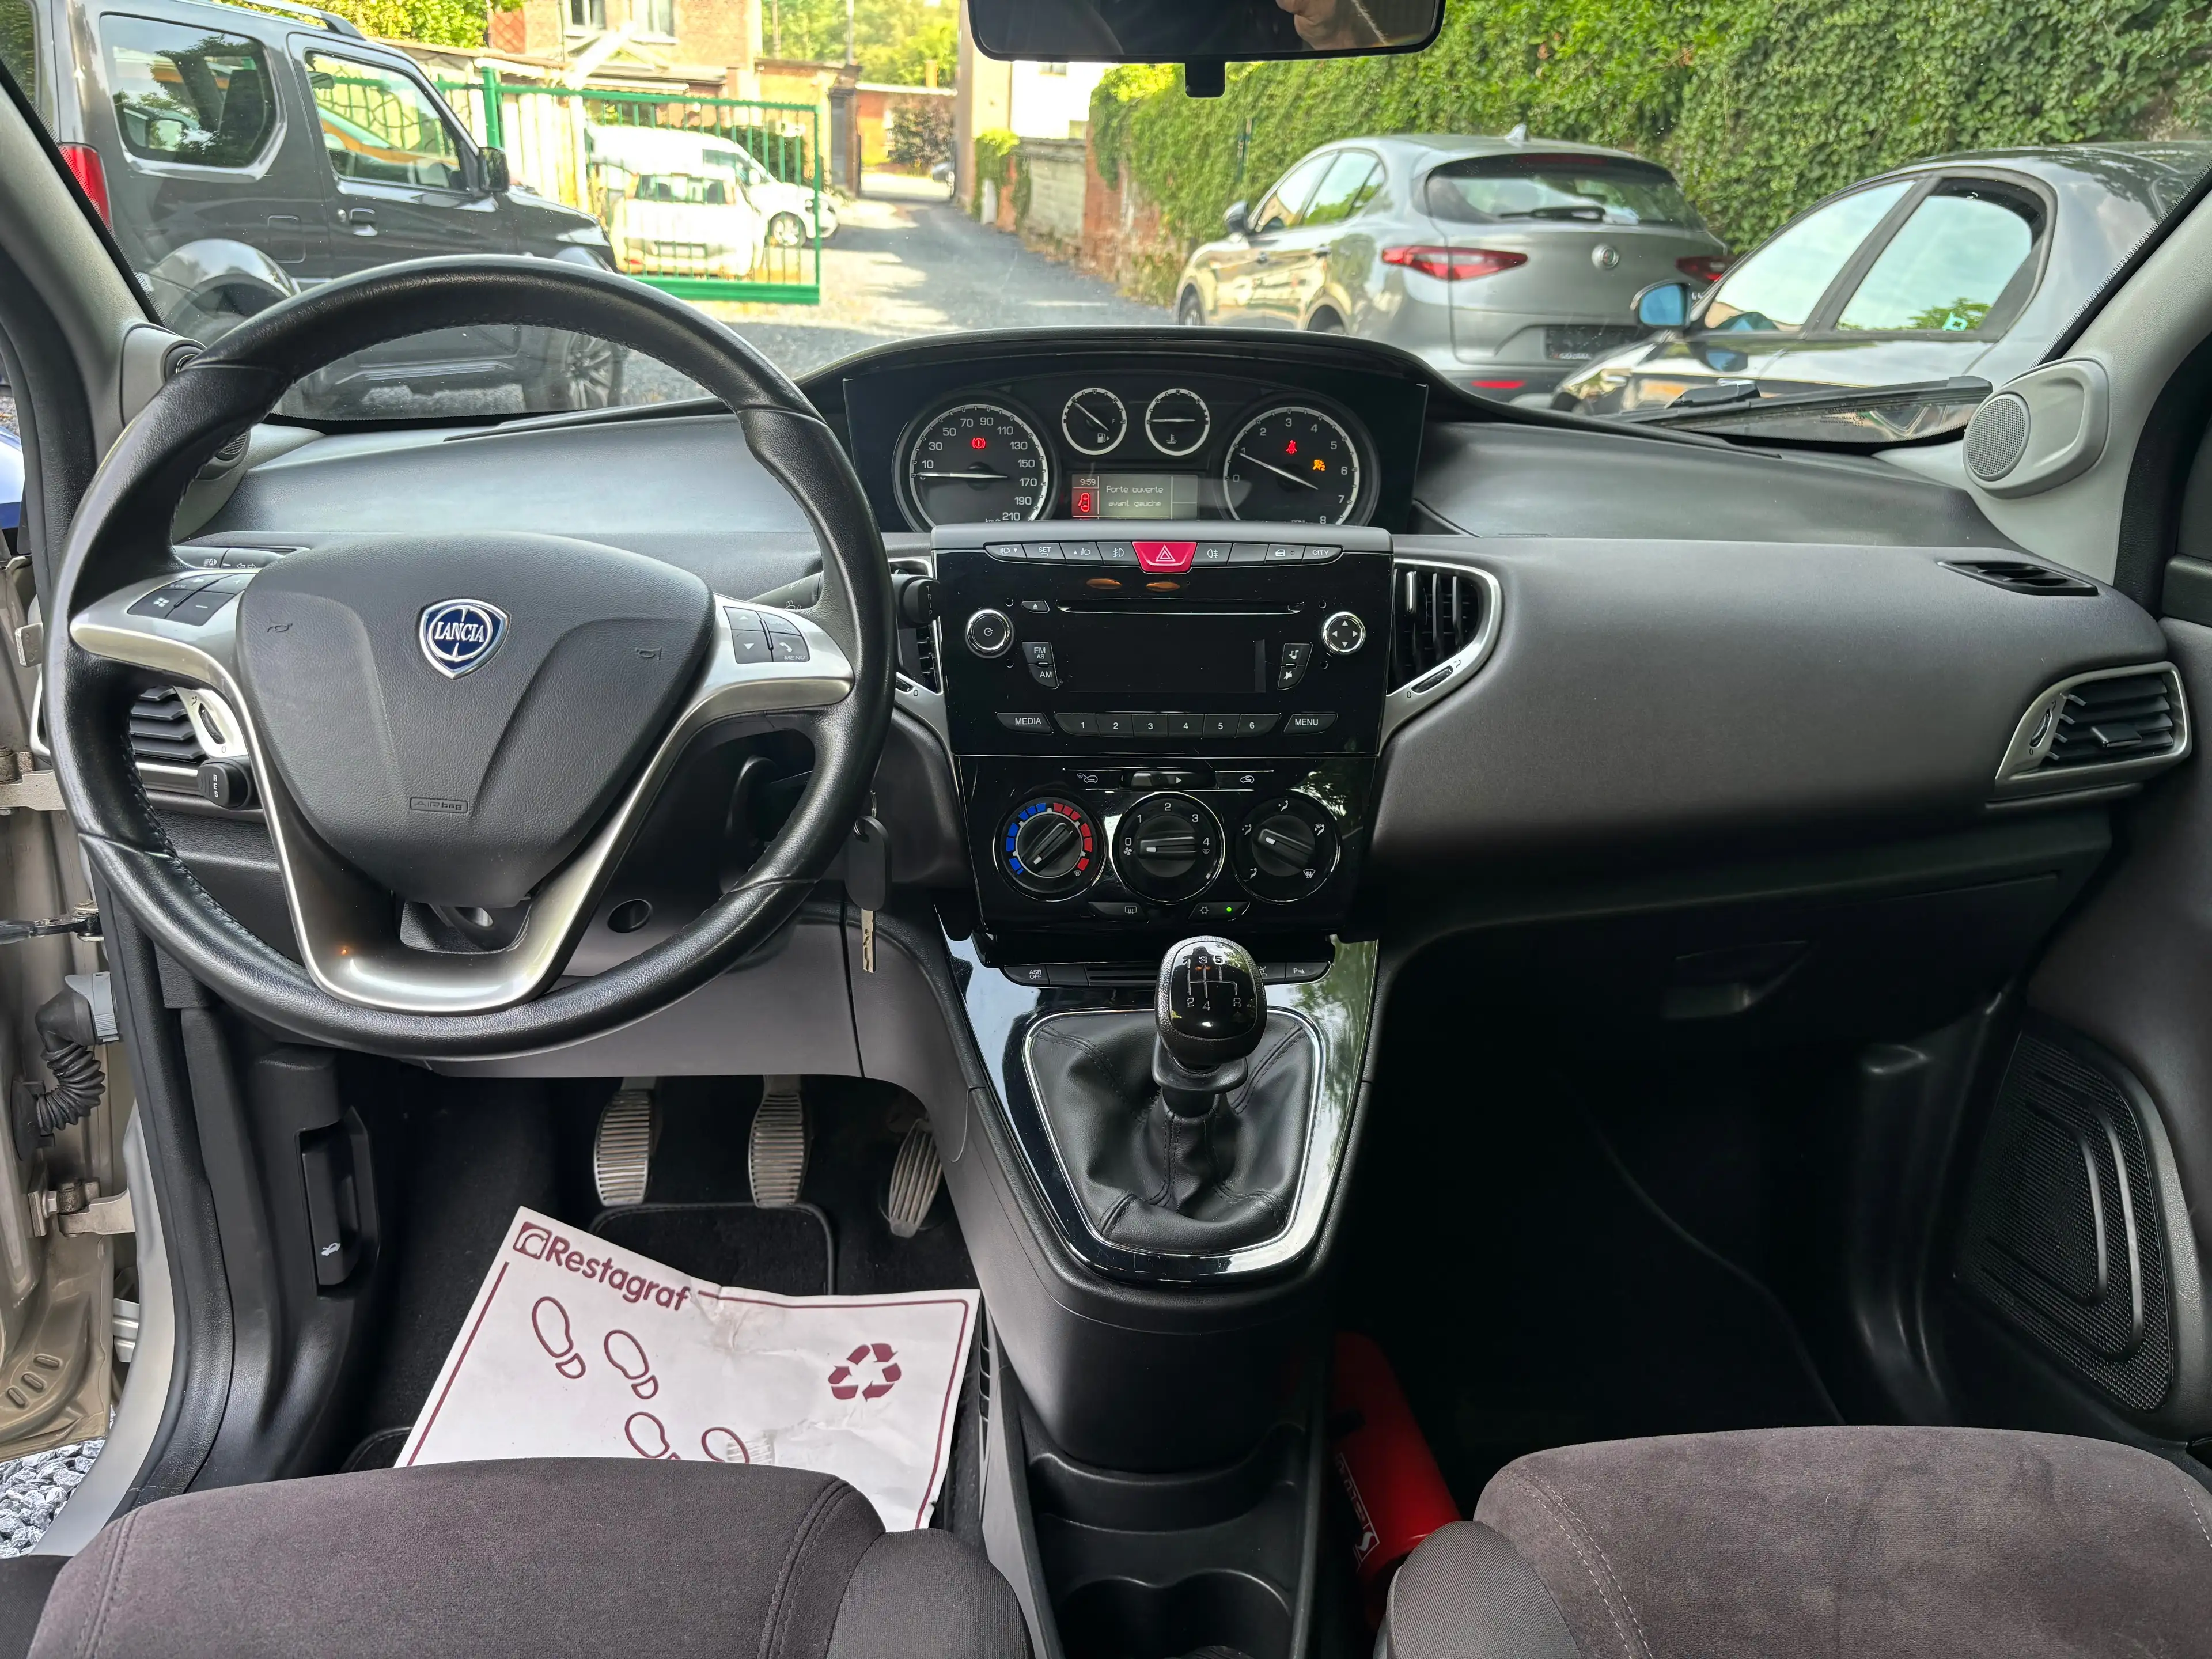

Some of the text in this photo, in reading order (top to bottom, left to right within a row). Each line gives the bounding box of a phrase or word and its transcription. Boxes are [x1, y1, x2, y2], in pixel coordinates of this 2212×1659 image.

[960, 418, 974, 427] 70
[980, 417, 994, 426] 90
[1285, 418, 1292, 427] 3
[943, 427, 956, 436] 50
[997, 426, 1013, 435] 110
[1260, 427, 1267, 436] 2
[1310, 424, 1318, 432] 4
[929, 442, 942, 450] 30
[1010, 441, 1028, 450] 130
[1331, 441, 1337, 449] 5
[922, 460, 934, 468] 10
[1018, 460, 1035, 468] 150
[1341, 467, 1348, 475] 6
[1020, 478, 1037, 486] 170
[1233, 474, 1240, 482] 0
[1014, 497, 1032, 505] 190
[1338, 495, 1345, 503] 7
[1002, 512, 1020, 521] 210
[1320, 516, 1327, 524] 8
[434, 622, 485, 642] LANCIA
[1164, 802, 1171, 811] 2
[1137, 814, 1142, 823] 1
[1192, 814, 1199, 823] 3
[1125, 838, 1132, 846] 0
[1202, 837, 1210, 846] 4
[1199, 956, 1207, 964] 3
[1213, 955, 1224, 965] 5
[1187, 997, 1195, 1007] 2
[1202, 1000, 1210, 1011] 4
[1233, 998, 1241, 1007] R
[545, 1236, 691, 1311] Restagraf
